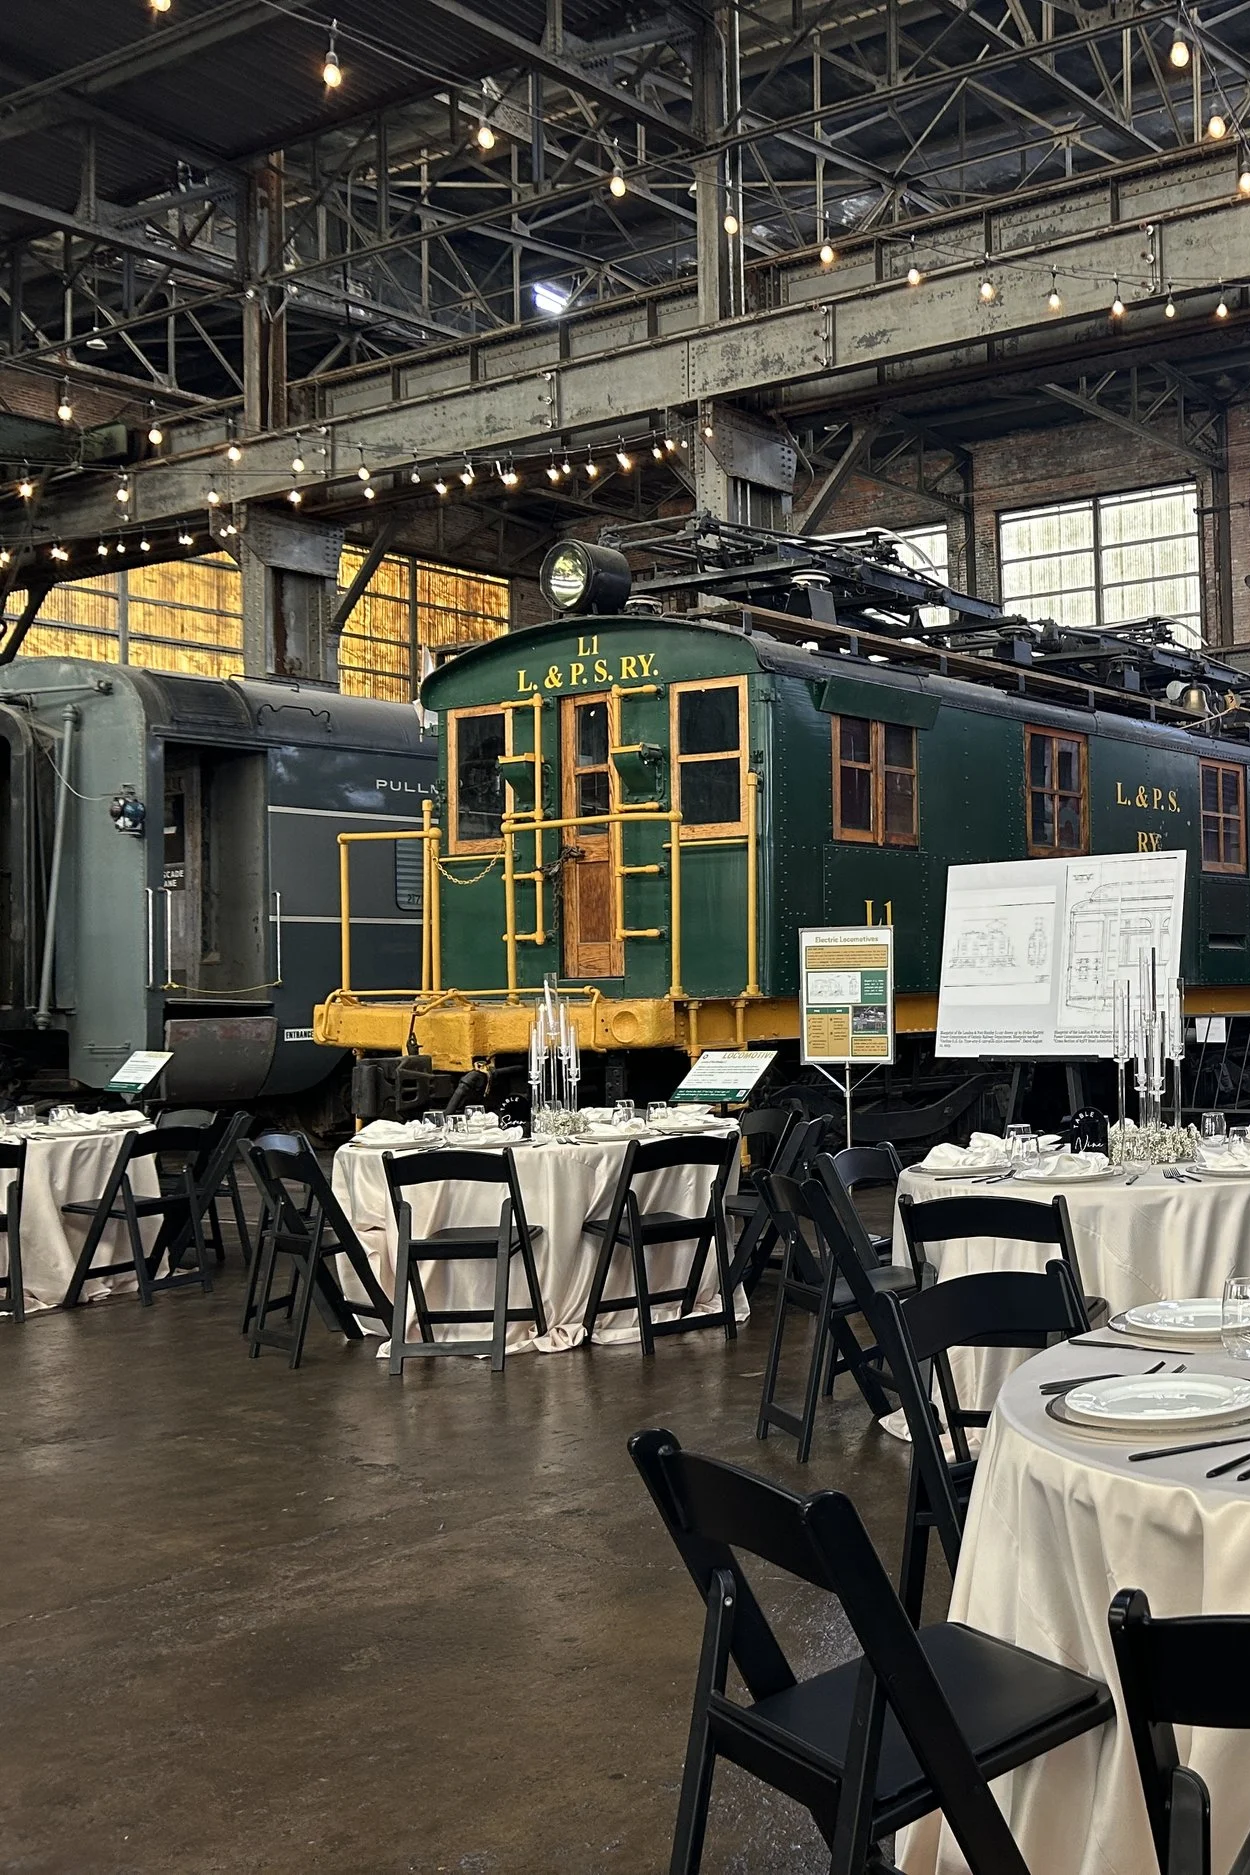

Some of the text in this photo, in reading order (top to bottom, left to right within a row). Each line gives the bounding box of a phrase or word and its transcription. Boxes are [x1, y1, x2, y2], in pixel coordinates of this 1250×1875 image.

[577, 635, 599, 657] L1
[517, 653, 659, 692] L. & P. S. RY.
[1116, 782, 1180, 813] L. & P. S.
[1073, 1111, 1095, 1129] TABLE
